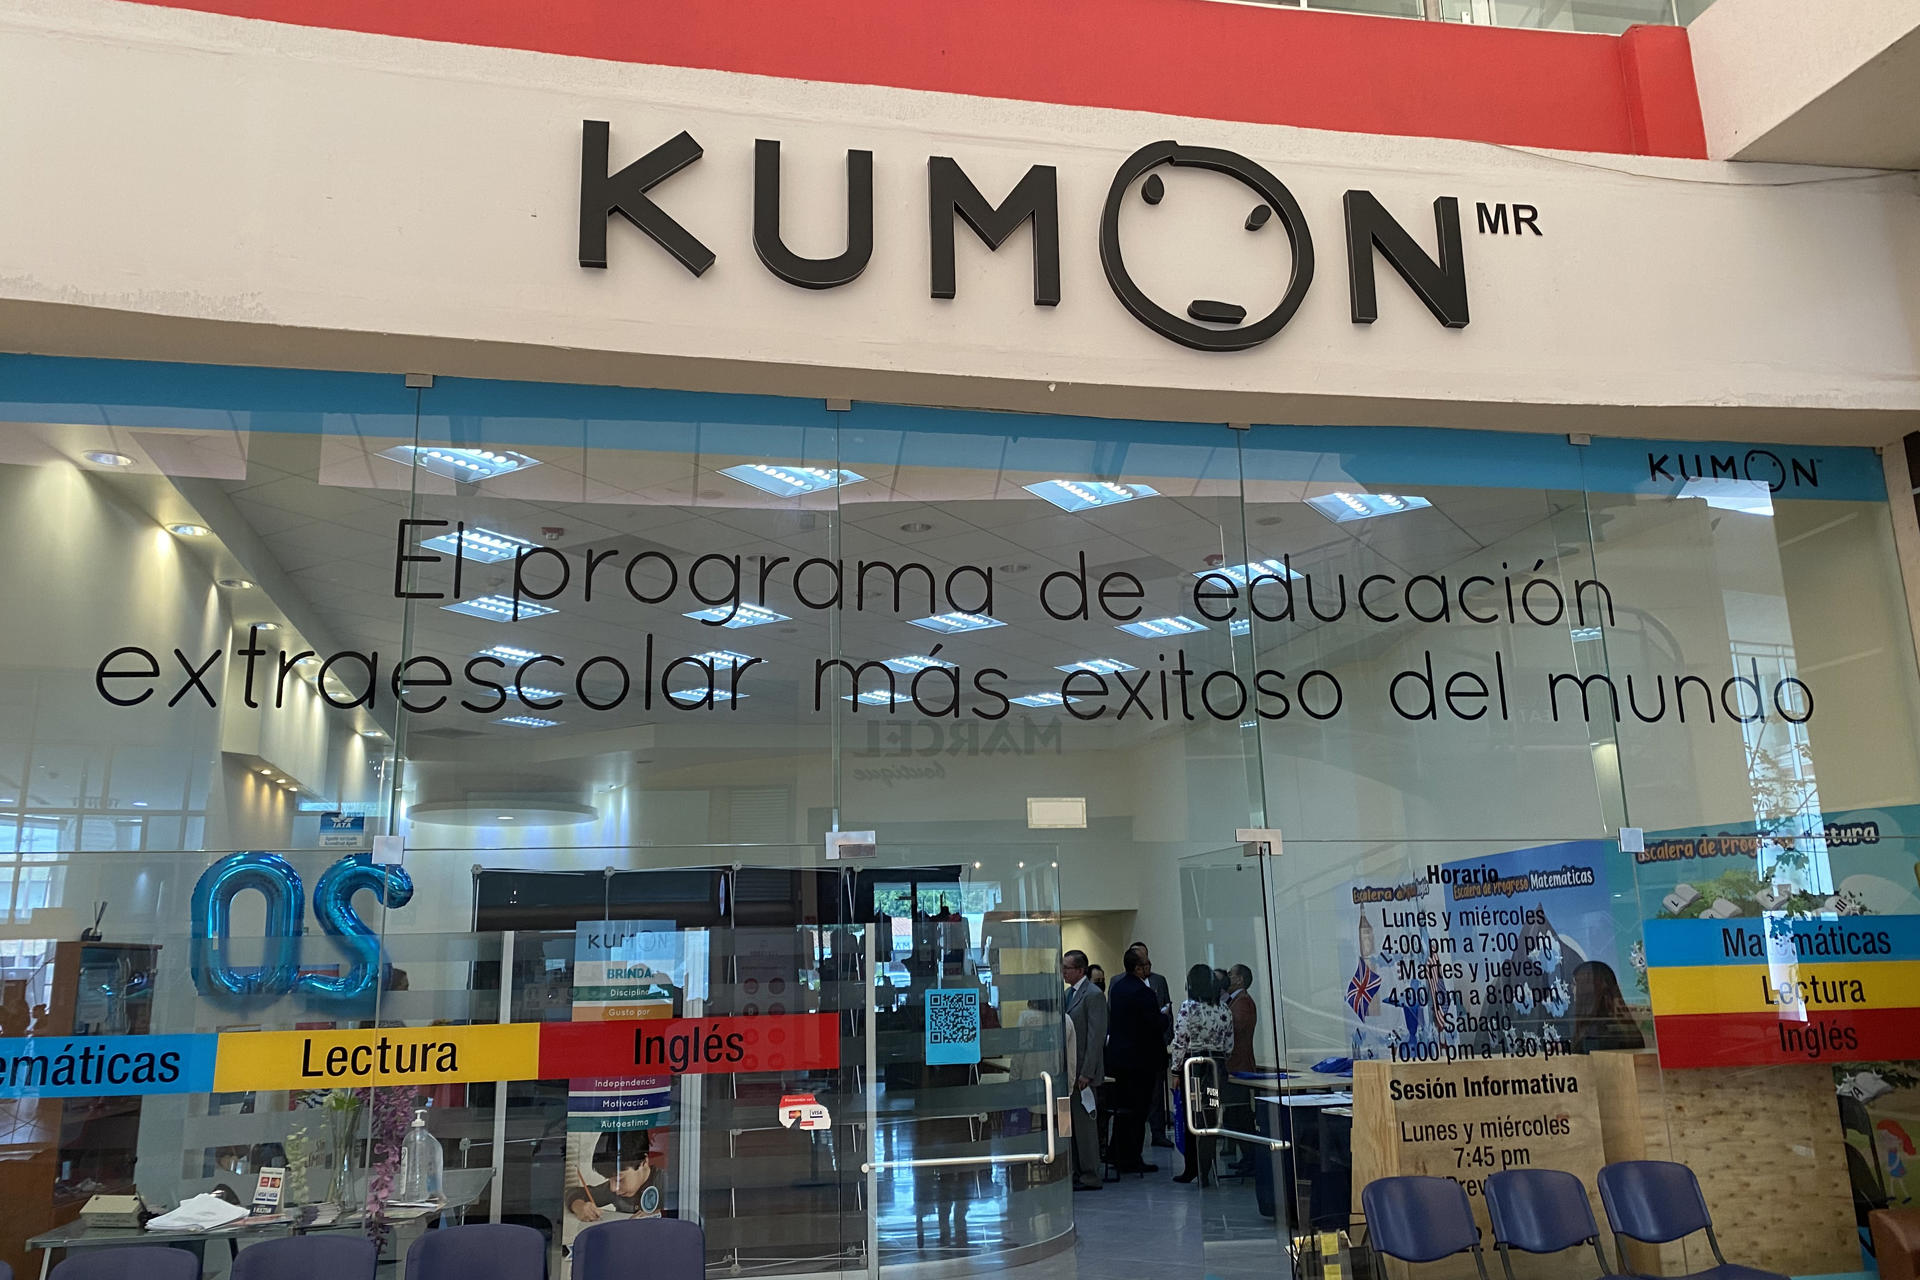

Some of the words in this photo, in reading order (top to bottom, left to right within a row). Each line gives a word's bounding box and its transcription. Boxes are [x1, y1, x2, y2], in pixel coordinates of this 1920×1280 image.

[579, 119, 1469, 353] KUMON
[1475, 202, 1543, 236] MR
[1648, 450, 1818, 493] KUMON
[394, 519, 465, 600] El
[511, 544, 992, 628] programa
[1040, 551, 1144, 622] de
[1193, 554, 1616, 627] educación
[96, 626, 763, 713] extraescolar
[815, 642, 1010, 721] más
[1061, 649, 1343, 722] exitoso
[1390, 651, 1508, 720] del
[1549, 657, 1814, 723] mundo
[1427, 863, 1499, 885] Horario
[1530, 868, 1594, 890] Matemáticas
[1382, 907, 1438, 928] Lunes
[1441, 911, 1452, 932] y
[1459, 904, 1546, 927] miércoles
[1382, 934, 1422, 954] 4:00
[1429, 937, 1457, 959] pm
[1463, 937, 1474, 953] a
[1479, 932, 1519, 953] 7:00
[1525, 935, 1553, 956] pm
[1722, 925, 1892, 958] Mamáticas
[1400, 958, 1463, 980] Martes
[1470, 961, 1479, 983] y
[1484, 958, 1543, 982] jueves
[1388, 986, 1429, 1008] 4:00
[1434, 989, 1463, 1012] pm
[1469, 988, 1482, 1005] a
[1486, 983, 1526, 1005] 8:00
[1532, 986, 1562, 1008] pm
[1761, 974, 1867, 1005] Lectura
[608, 1008, 635, 1017] Gusto
[637, 1008, 651, 1019] por
[1443, 1010, 1512, 1034] Sábado
[301, 1036, 459, 1078] Lectura
[634, 1023, 745, 1073] Inglés
[1388, 1040, 1440, 1063] 10:00
[1445, 1041, 1479, 1066] pm
[1481, 1043, 1493, 1060] a
[1498, 1037, 1538, 1059] 1:30
[1543, 1038, 1572, 1062] pm
[1778, 1018, 1859, 1059] Inglés
[594, 1078, 656, 1089] Independencia
[1389, 1077, 1458, 1101] Sesión
[1463, 1073, 1579, 1097] Informativa
[602, 1098, 649, 1108] Motivación
[600, 1119, 649, 1129] Autoestima
[1401, 1120, 1458, 1143] Lunes
[1463, 1122, 1474, 1144] y
[1480, 1115, 1570, 1139] miércoles
[1453, 1145, 1495, 1169] 7:45
[1501, 1147, 1531, 1170] pm
